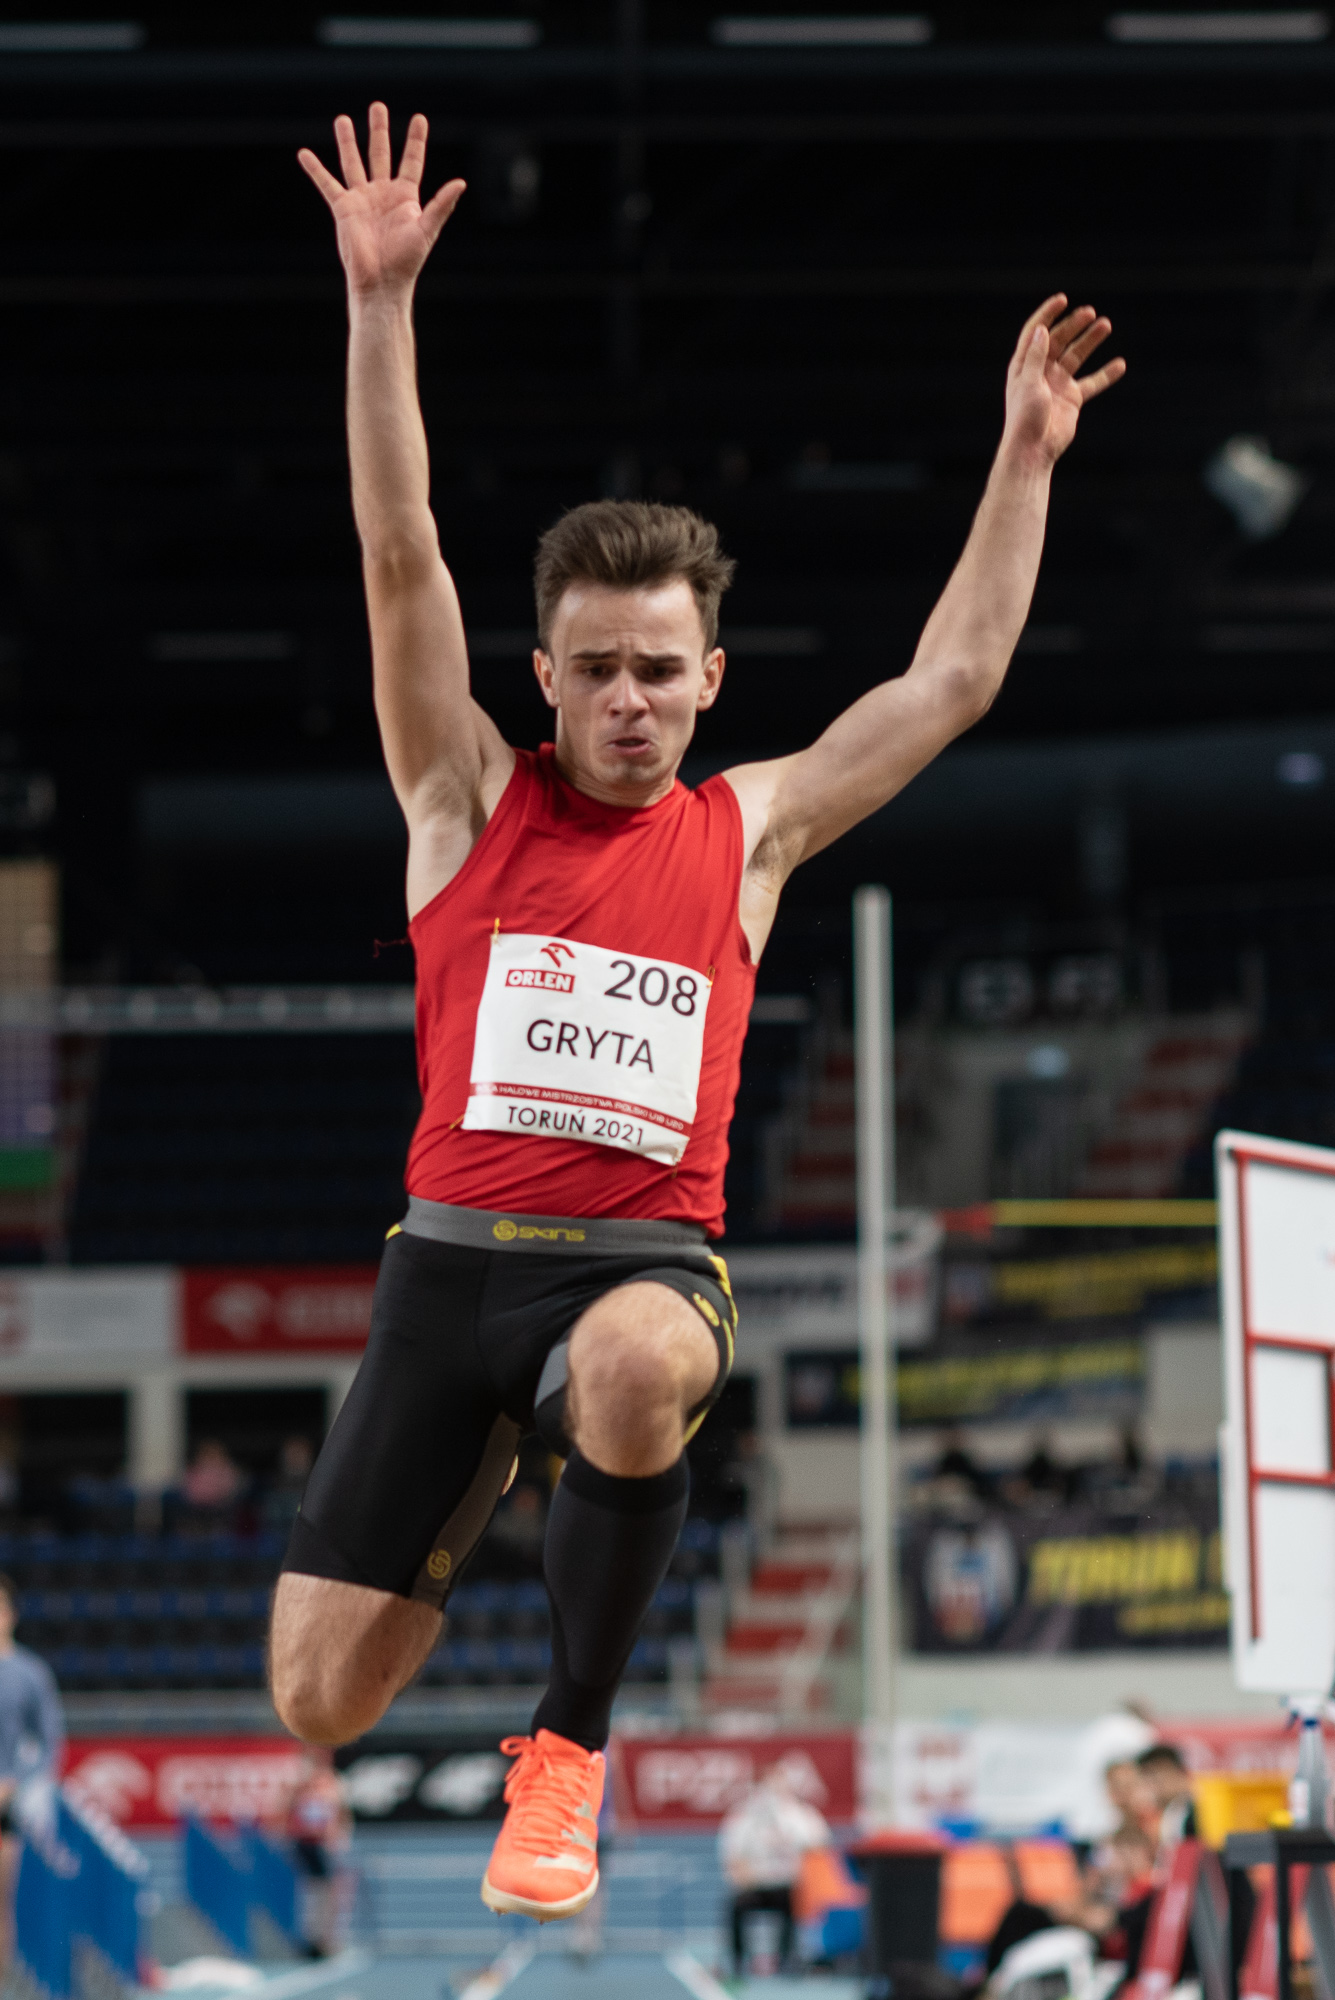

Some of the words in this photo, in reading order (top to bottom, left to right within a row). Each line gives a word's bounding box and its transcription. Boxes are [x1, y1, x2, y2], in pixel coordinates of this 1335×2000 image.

[507, 970, 572, 992] ORLEN
[604, 959, 698, 1017] 208
[526, 1019, 654, 1074] GRYTA
[508, 1106, 585, 1134] TORUŃ
[593, 1117, 644, 1146] 2021
